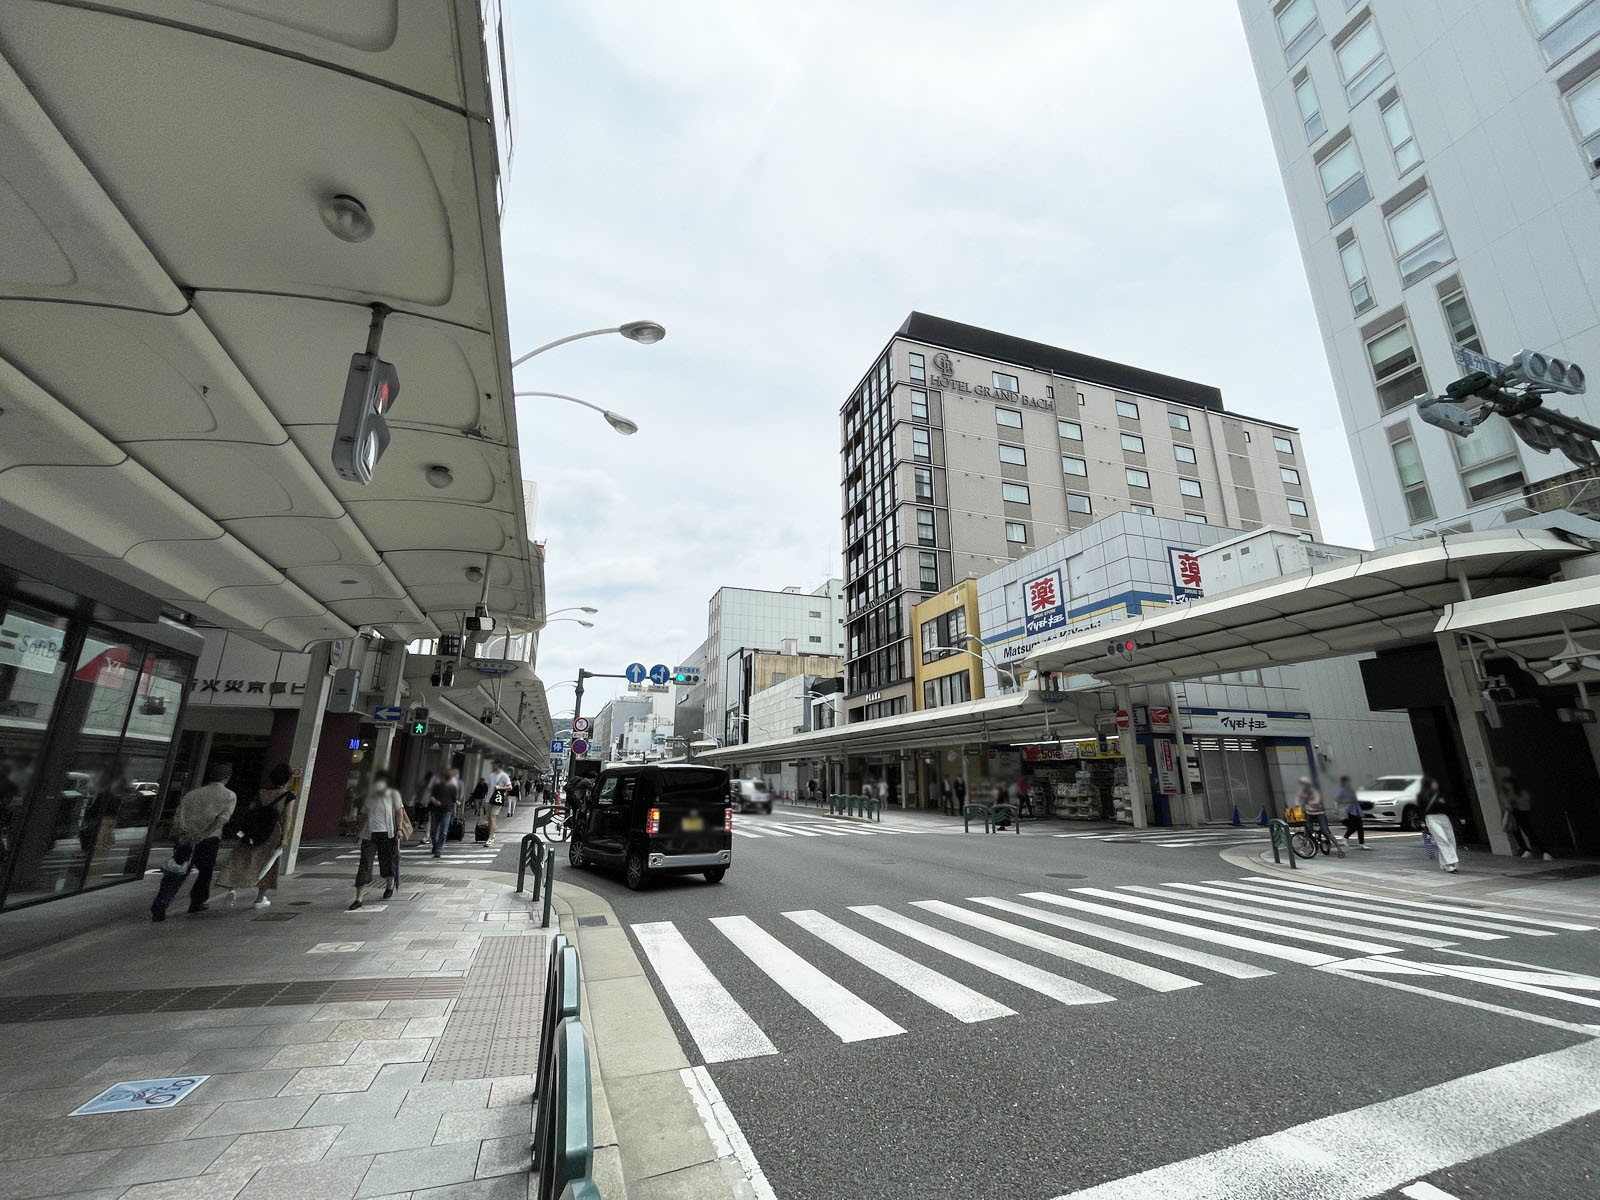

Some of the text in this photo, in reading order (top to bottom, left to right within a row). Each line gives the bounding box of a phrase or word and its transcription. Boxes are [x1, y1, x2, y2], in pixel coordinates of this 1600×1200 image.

[930, 374, 1055, 412] HOTEL GRAND BACH
[1030, 577, 1055, 611] 薬
[1220, 716, 1268, 731] マツモトキヨシ
